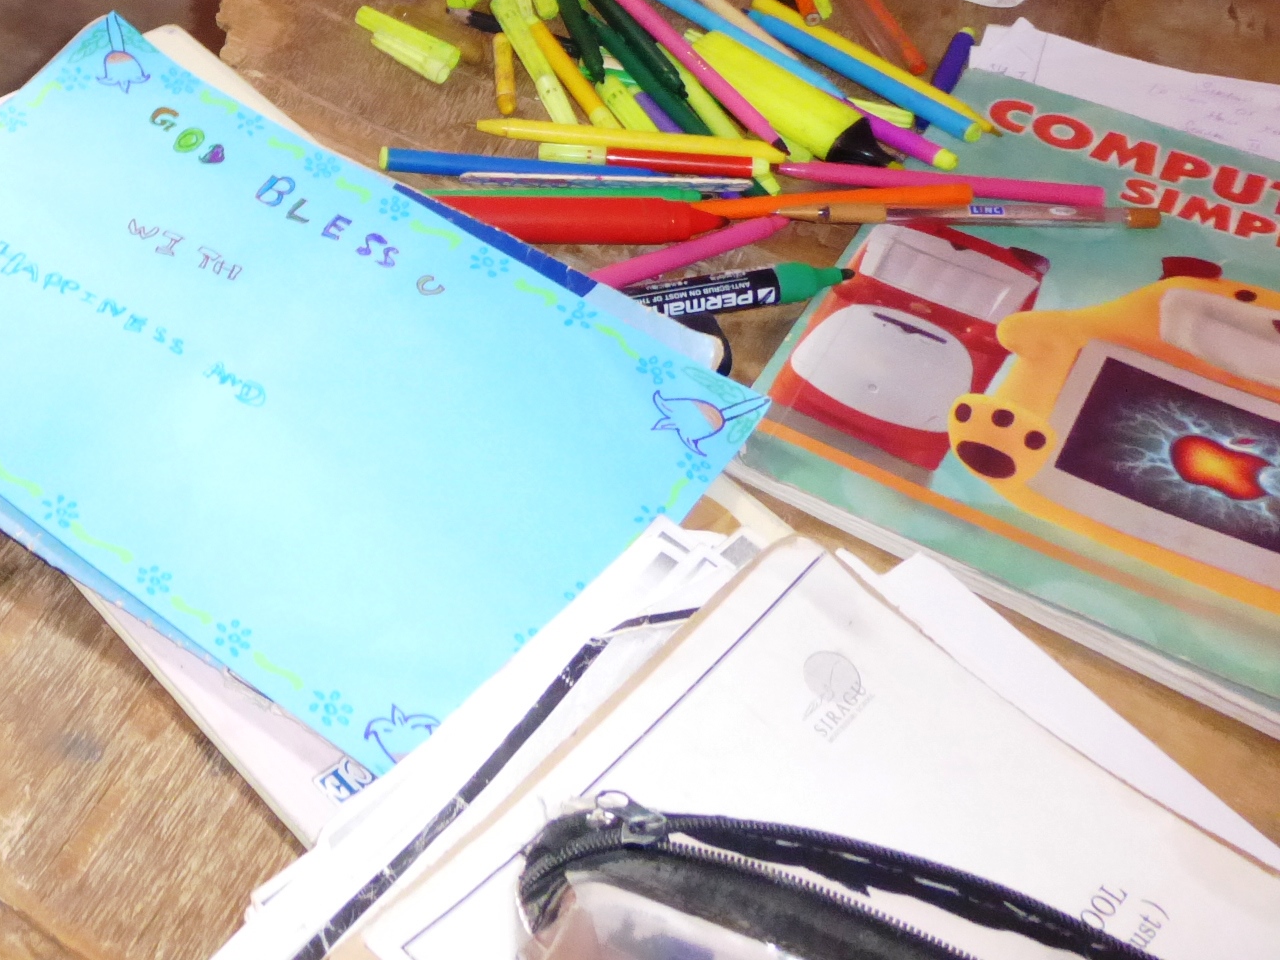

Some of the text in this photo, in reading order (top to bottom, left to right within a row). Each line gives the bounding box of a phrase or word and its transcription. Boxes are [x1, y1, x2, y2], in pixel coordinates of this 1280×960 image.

[988, 99, 1280, 214] COMPU
[149, 106, 226, 165] GOD
[255, 175, 400, 269] BLESS
[971, 205, 1003, 215] LINC
[1120, 179, 1280, 248] SIMP
[127, 218, 243, 281] WITH
[665, 291, 688, 300] MOST
[689, 289, 701, 297] ON
[202, 360, 267, 408] AND
